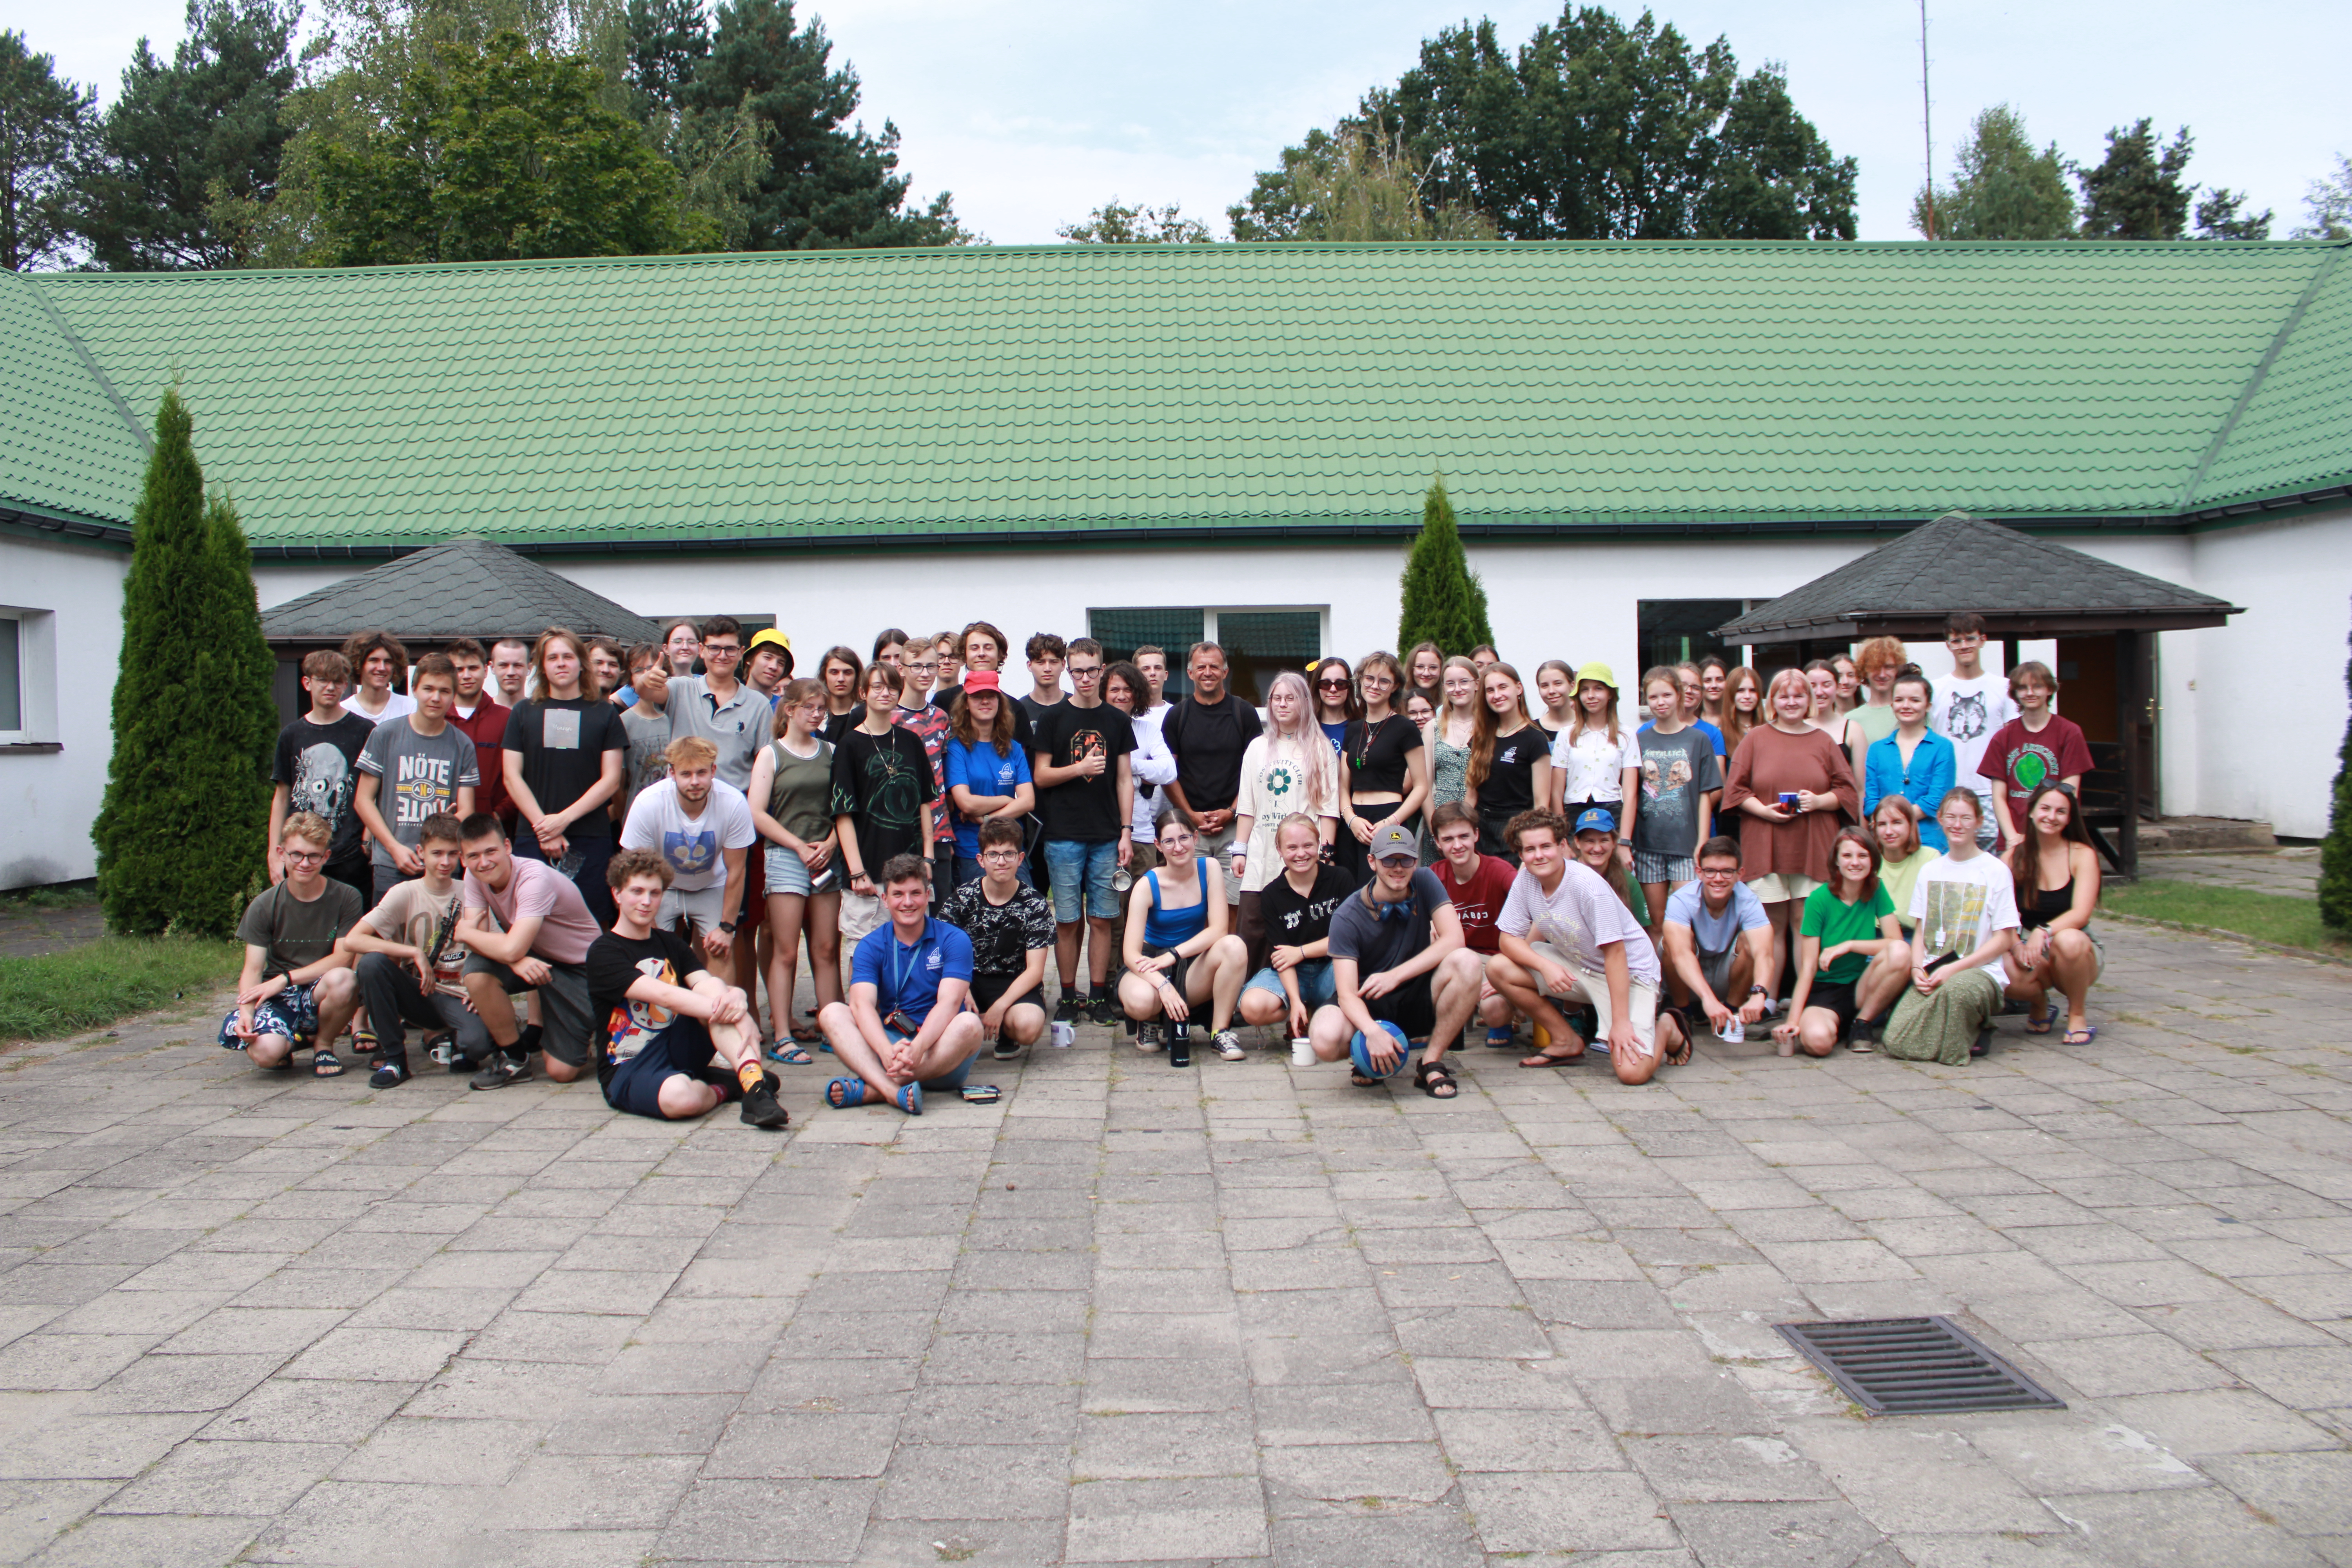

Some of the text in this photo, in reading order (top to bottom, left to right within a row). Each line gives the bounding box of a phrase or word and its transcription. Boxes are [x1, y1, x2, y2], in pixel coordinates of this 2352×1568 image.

[398, 753, 450, 786] NÖTE
[1292, 765, 1303, 786] CLUB
[414, 783, 432, 797] AND
[316, 1054, 339, 1063] NASA
